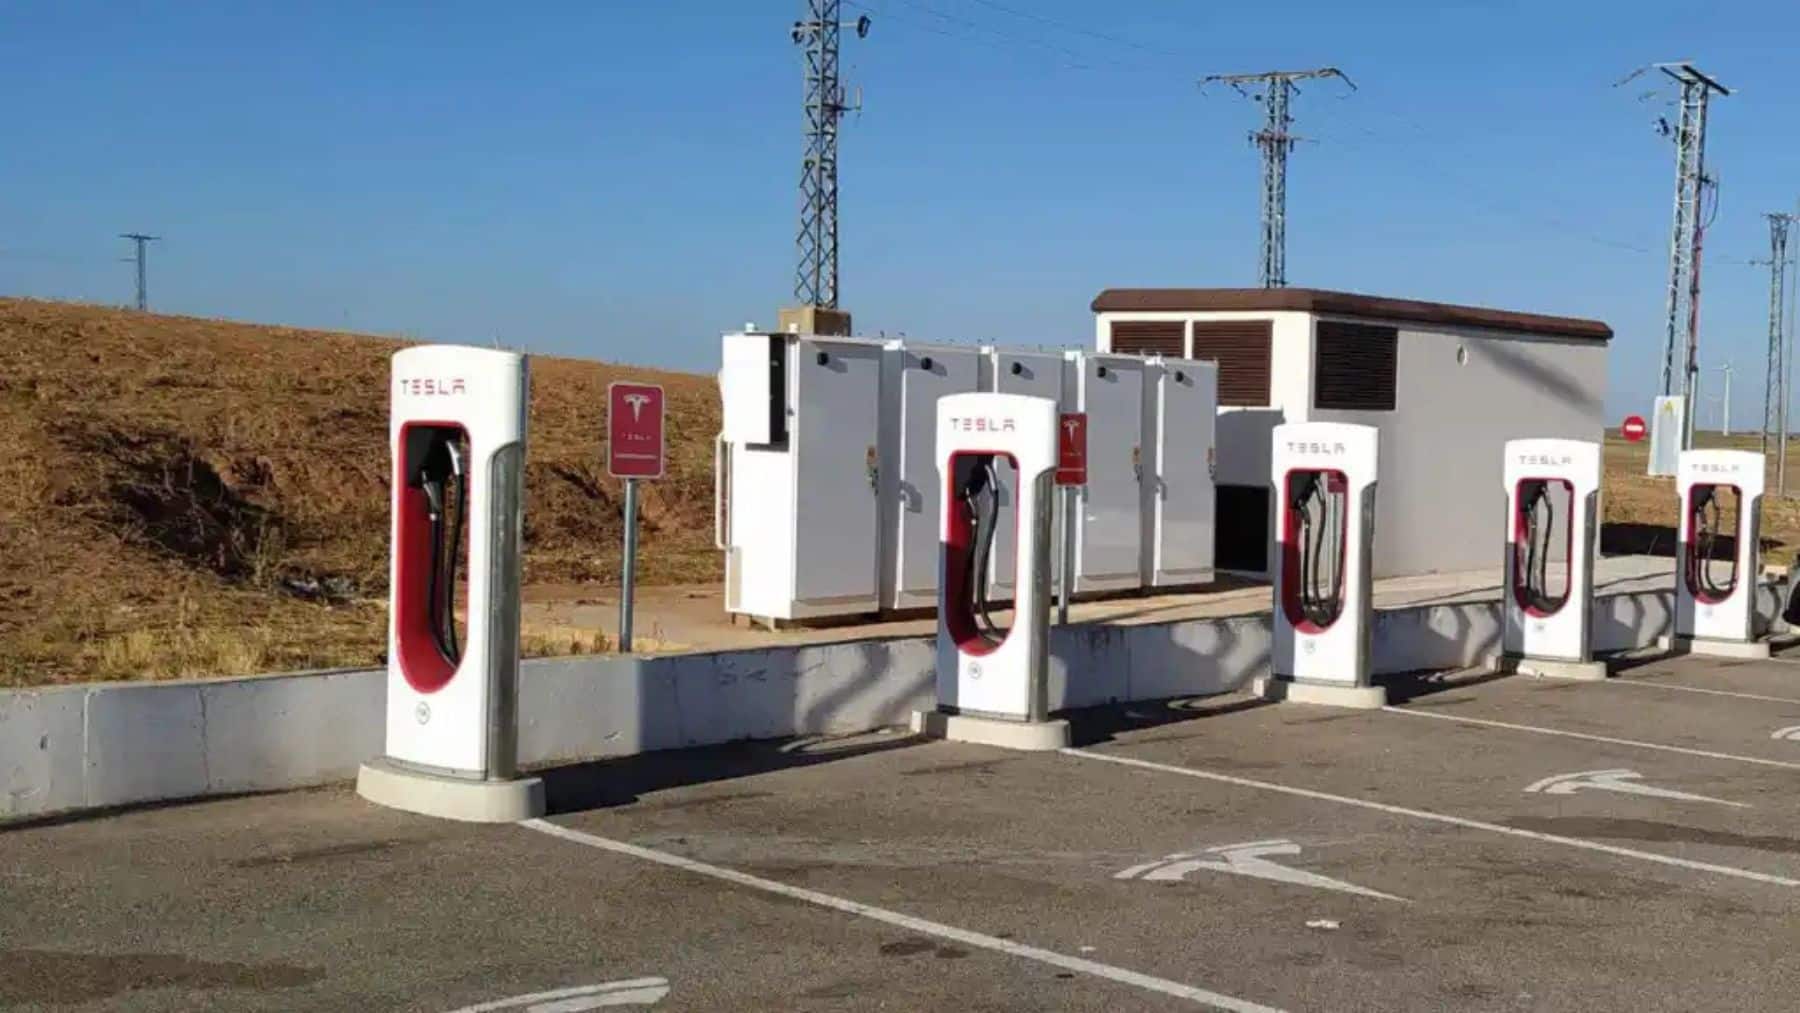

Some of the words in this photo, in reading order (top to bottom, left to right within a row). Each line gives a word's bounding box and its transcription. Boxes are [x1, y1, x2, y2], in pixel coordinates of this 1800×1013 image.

[399, 379, 466, 395] TESLA
[950, 417, 1016, 431] TESLA
[1286, 442, 1345, 454] TESLA
